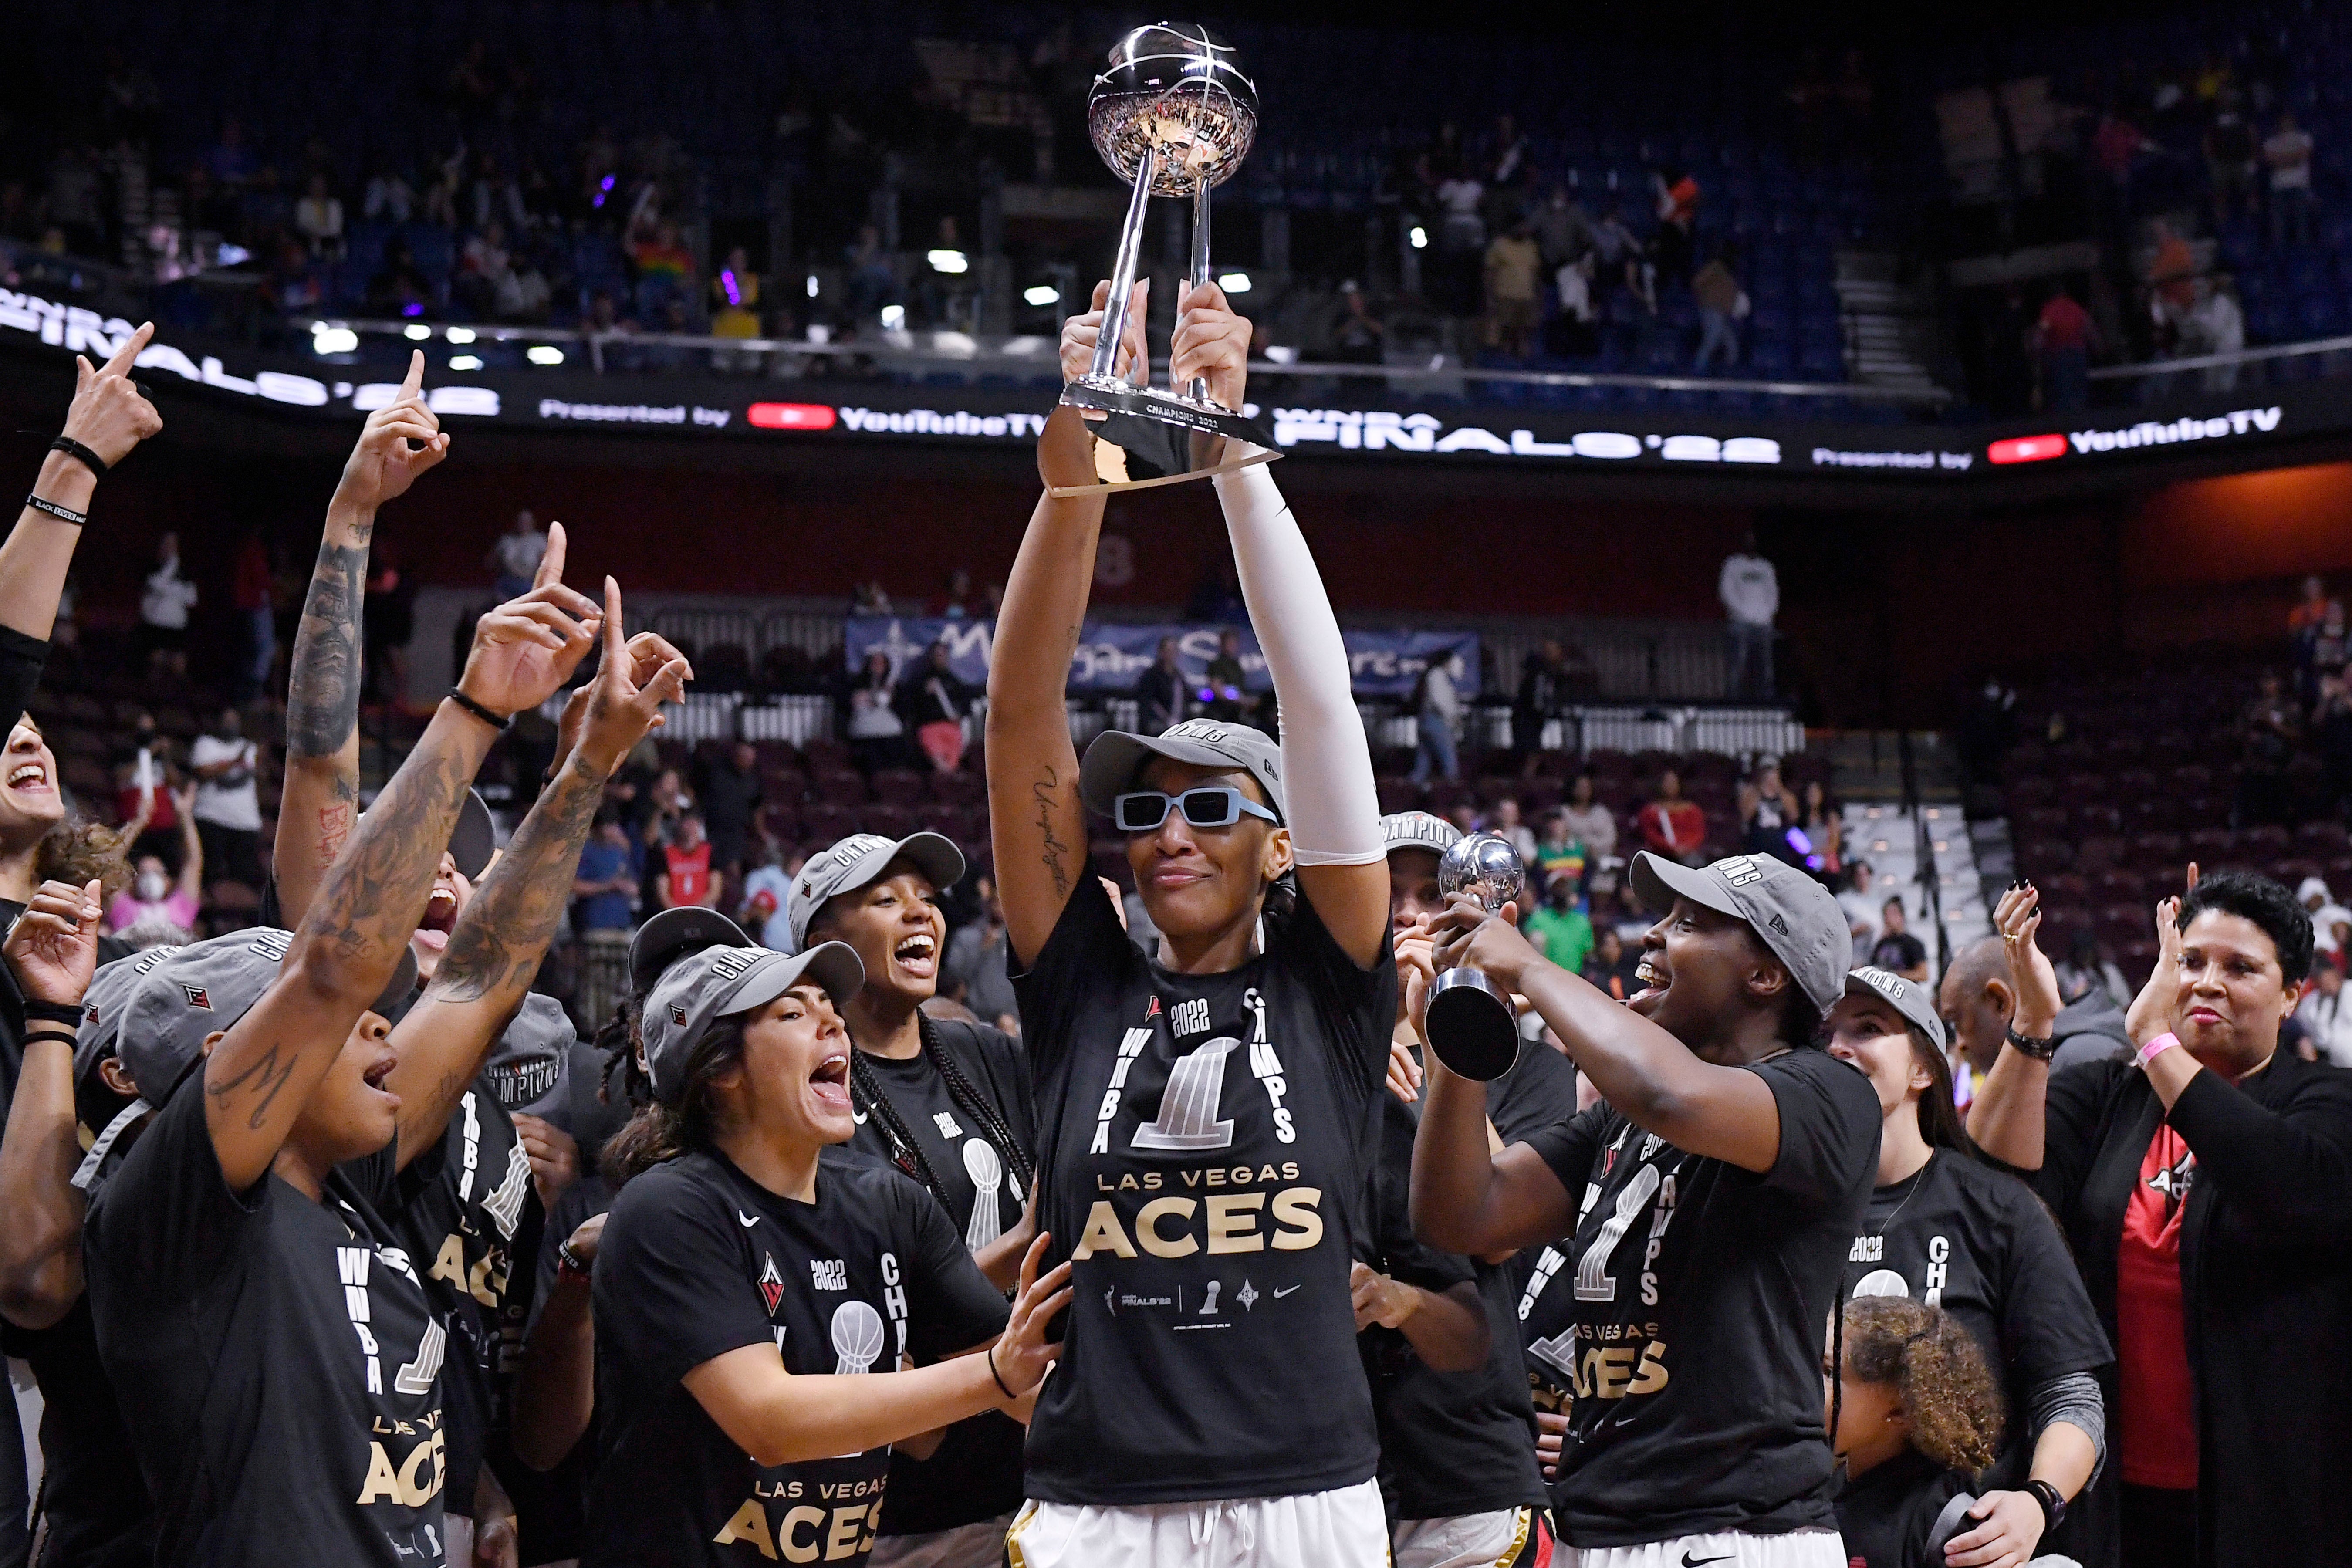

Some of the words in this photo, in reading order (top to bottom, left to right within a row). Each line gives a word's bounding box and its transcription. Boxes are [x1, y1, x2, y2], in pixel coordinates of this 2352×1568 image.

[692, 406, 730, 428] by
[1146, 404, 1195, 422] CHAMPIONS
[1198, 416, 1218, 429] 2022
[36, 500, 54, 512] BLACK
[54, 507, 77, 521] LIVES
[1382, 817, 1458, 848] HAMPION
[1170, 998, 1211, 1038] 2022
[1090, 1027, 1154, 1154] WNBA
[1097, 1172, 1163, 1191] LAS
[1180, 1162, 1300, 1188] VEGAS
[1071, 1187, 1324, 1260] ACES
[1848, 1236, 1883, 1262] 2022
[810, 1259, 848, 1291] 2022
[1924, 1236, 1950, 1306] CHA
[337, 1247, 383, 1395] WNBA
[881, 1252, 908, 1372] CHA
[1575, 1324, 1592, 1340] AS
[1596, 1321, 1659, 1341] VEGAS
[372, 1415, 416, 1436] LAS
[356, 1427, 446, 1507] ACE
[755, 1481, 803, 1498] LAS
[820, 1473, 888, 1500] VEGAS
[713, 1495, 884, 1564] ACES
